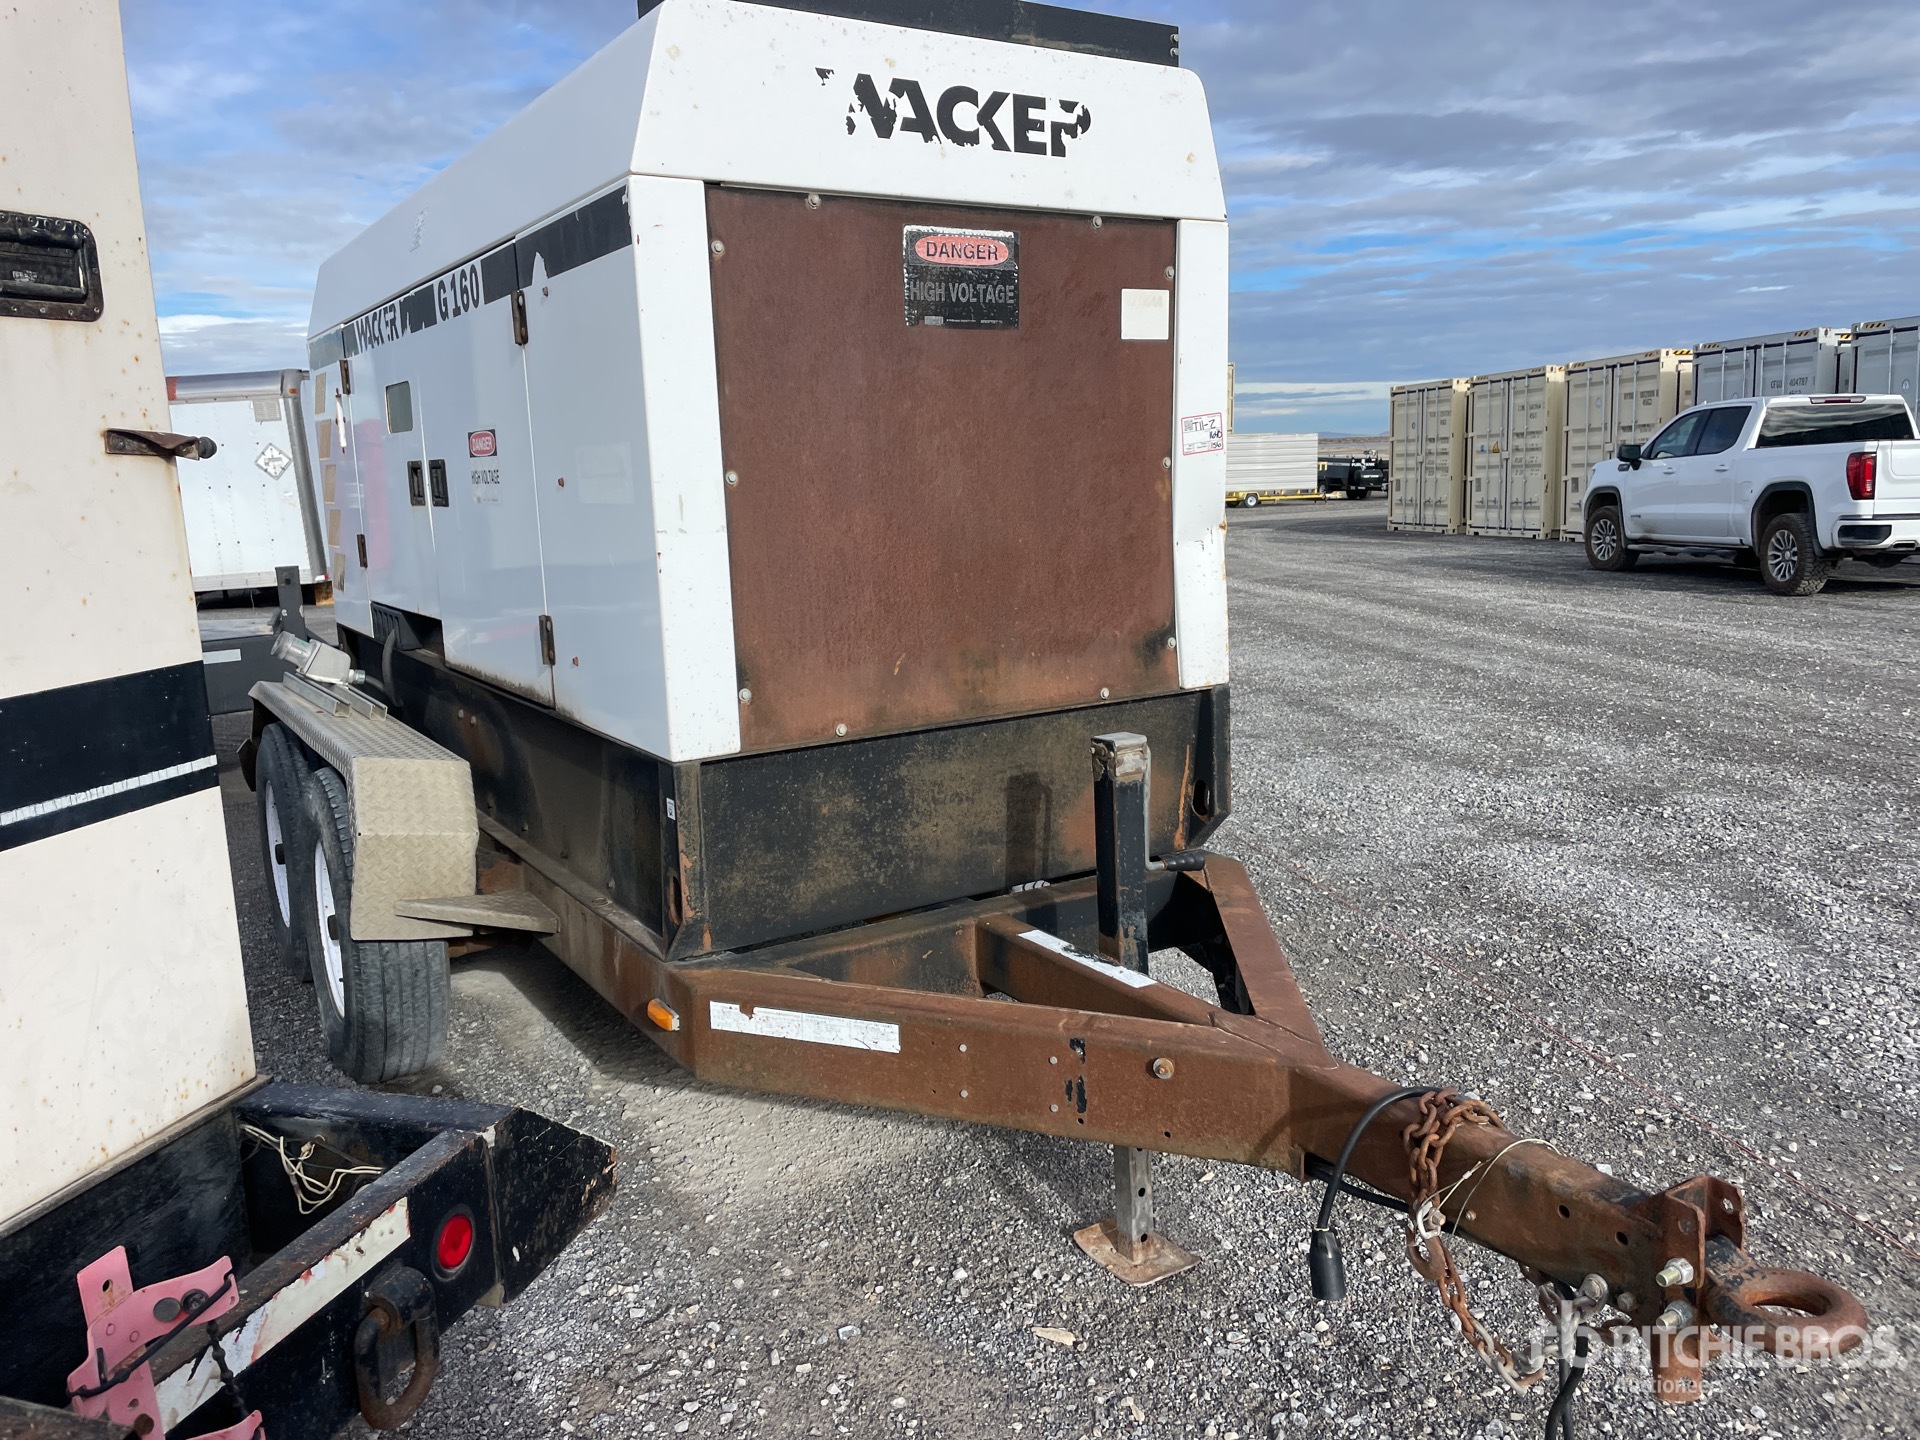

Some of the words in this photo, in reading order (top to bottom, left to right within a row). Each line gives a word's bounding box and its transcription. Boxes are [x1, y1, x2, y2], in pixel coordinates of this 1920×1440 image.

[925, 240, 999, 261] DANGER
[437, 279, 450, 322] G
[450, 264, 480, 318] 160
[909, 280, 946, 302] HIGH
[948, 282, 1015, 304] VOLTAGE
[472, 436, 493, 452] DANGER
[470, 470, 481, 485] HIGH
[481, 469, 500, 485] VOLTAGE
